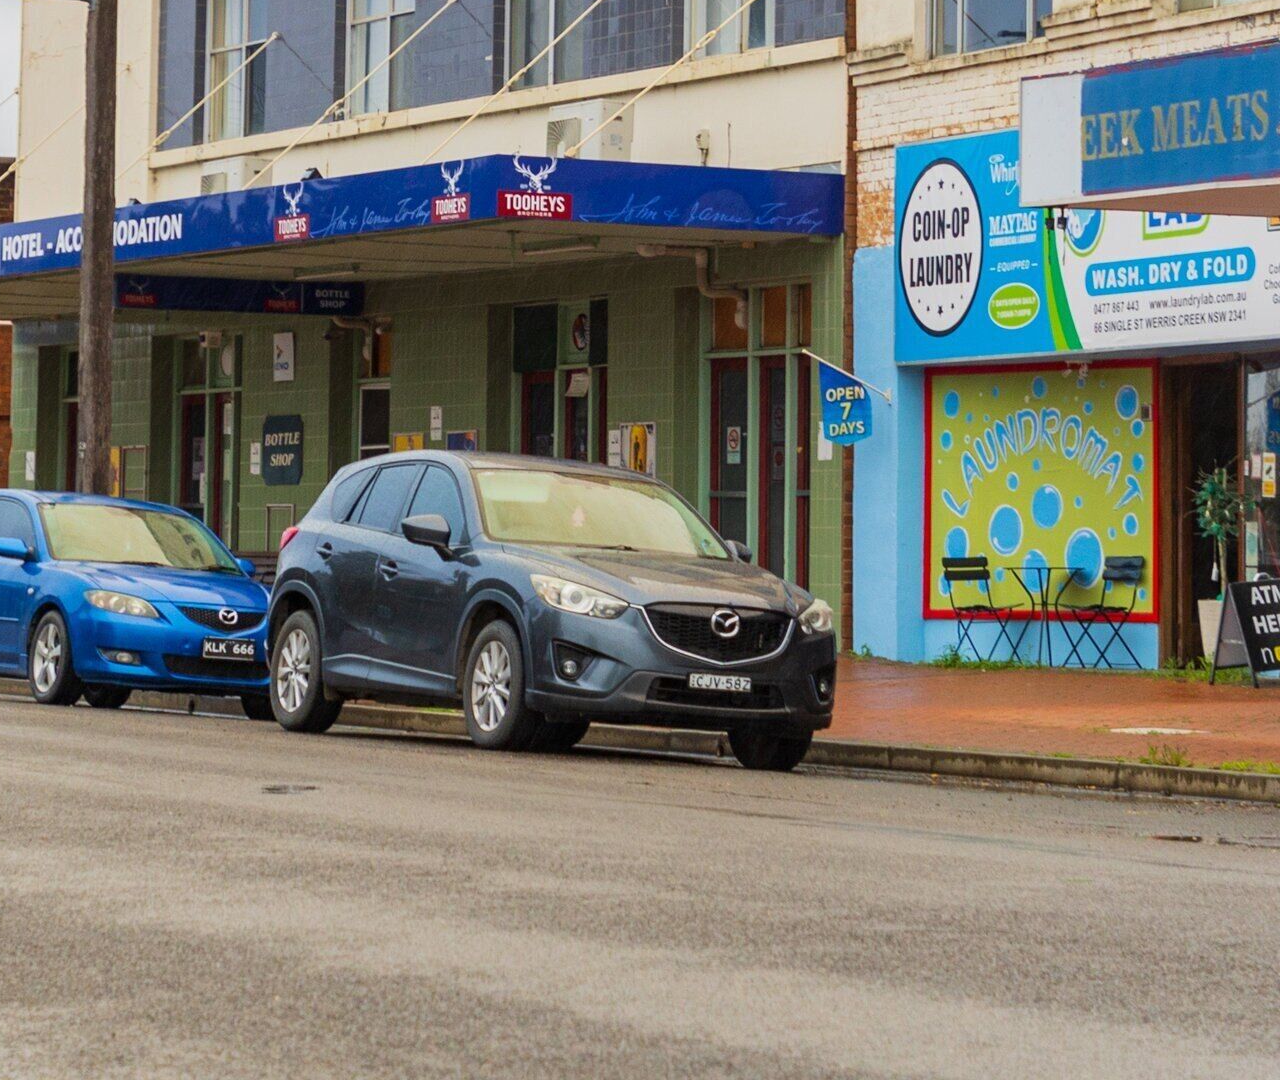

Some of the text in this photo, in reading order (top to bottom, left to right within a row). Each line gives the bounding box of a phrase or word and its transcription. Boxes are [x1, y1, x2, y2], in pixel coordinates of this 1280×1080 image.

[1151, 89, 1270, 153] MEATS
[435, 196, 467, 216] TOOHEYS
[505, 193, 566, 213] TOOHEYS
[278, 217, 307, 235] TOOHEYS
[912, 206, 970, 242] COIN-OP
[988, 211, 1038, 236] MAYTAG
[2, 232, 44, 262] HOTEL
[55, 213, 183, 255] ACCODATION
[909, 252, 973, 287] LAUNDRY
[996, 259, 1031, 272] EQUIPPED
[1092, 254, 1249, 290] WASH. DRY & FOLD
[315, 289, 350, 299] BOTTLE
[1093, 303, 1110, 315] 0477
[1126, 300, 1139, 312] 443
[1149, 291, 1247, 309] www.laundrylab.com.au
[319, 300, 346, 309] SHOP
[1104, 319, 1132, 333] SINGLE
[1134, 318, 1144, 330] ST
[1146, 315, 1177, 329] WERRIS
[1178, 314, 1207, 327] CREEK
[1208, 312, 1227, 324] NSW
[1228, 309, 1247, 322] 2341
[825, 386, 865, 402] OPEN
[840, 402, 852, 420] 7
[265, 432, 300, 446] BOTTLE
[829, 421, 865, 437] DAYS
[270, 453, 294, 467] SHOP
[941, 407, 1144, 518] LAUNDROMAT
[205, 641, 227, 653] KLK
[232, 643, 255, 655] 666
